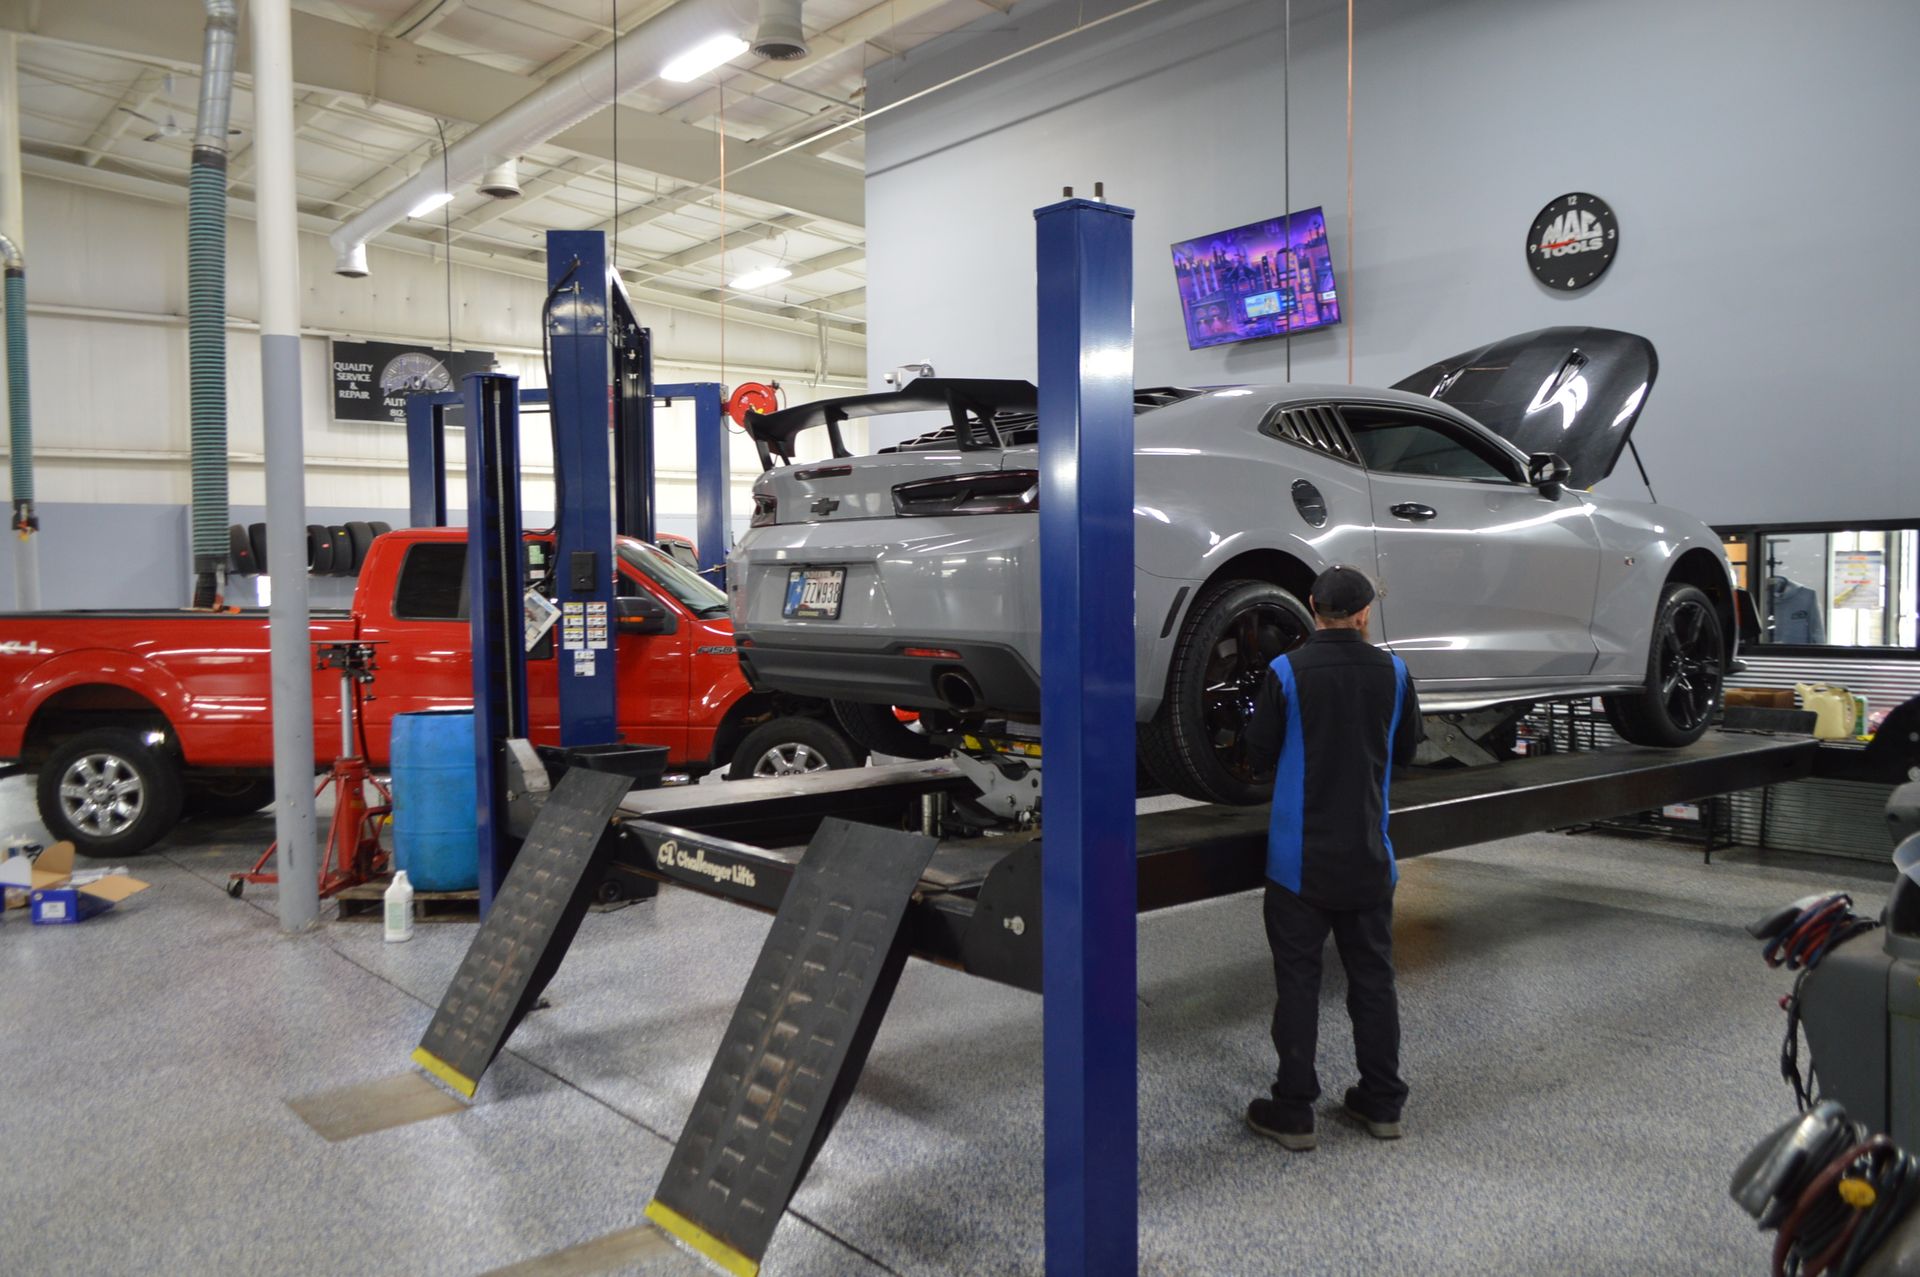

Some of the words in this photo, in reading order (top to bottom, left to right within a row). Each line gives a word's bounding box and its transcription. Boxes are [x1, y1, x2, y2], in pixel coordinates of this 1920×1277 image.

[1567, 196, 1578, 206] 12
[1541, 209, 1603, 246] MAC
[1607, 229, 1615, 240] 3
[1530, 245, 1537, 254] 9
[1541, 238, 1603, 259] TOOLS
[1567, 277, 1575, 287] 6
[334, 362, 374, 372] QUALITY
[336, 372, 372, 382] SERVICE
[350, 382, 358, 390] &
[339, 390, 370, 400] REPAIR
[677, 848, 732, 883] Challenger
[732, 864, 757, 888] Lifts
